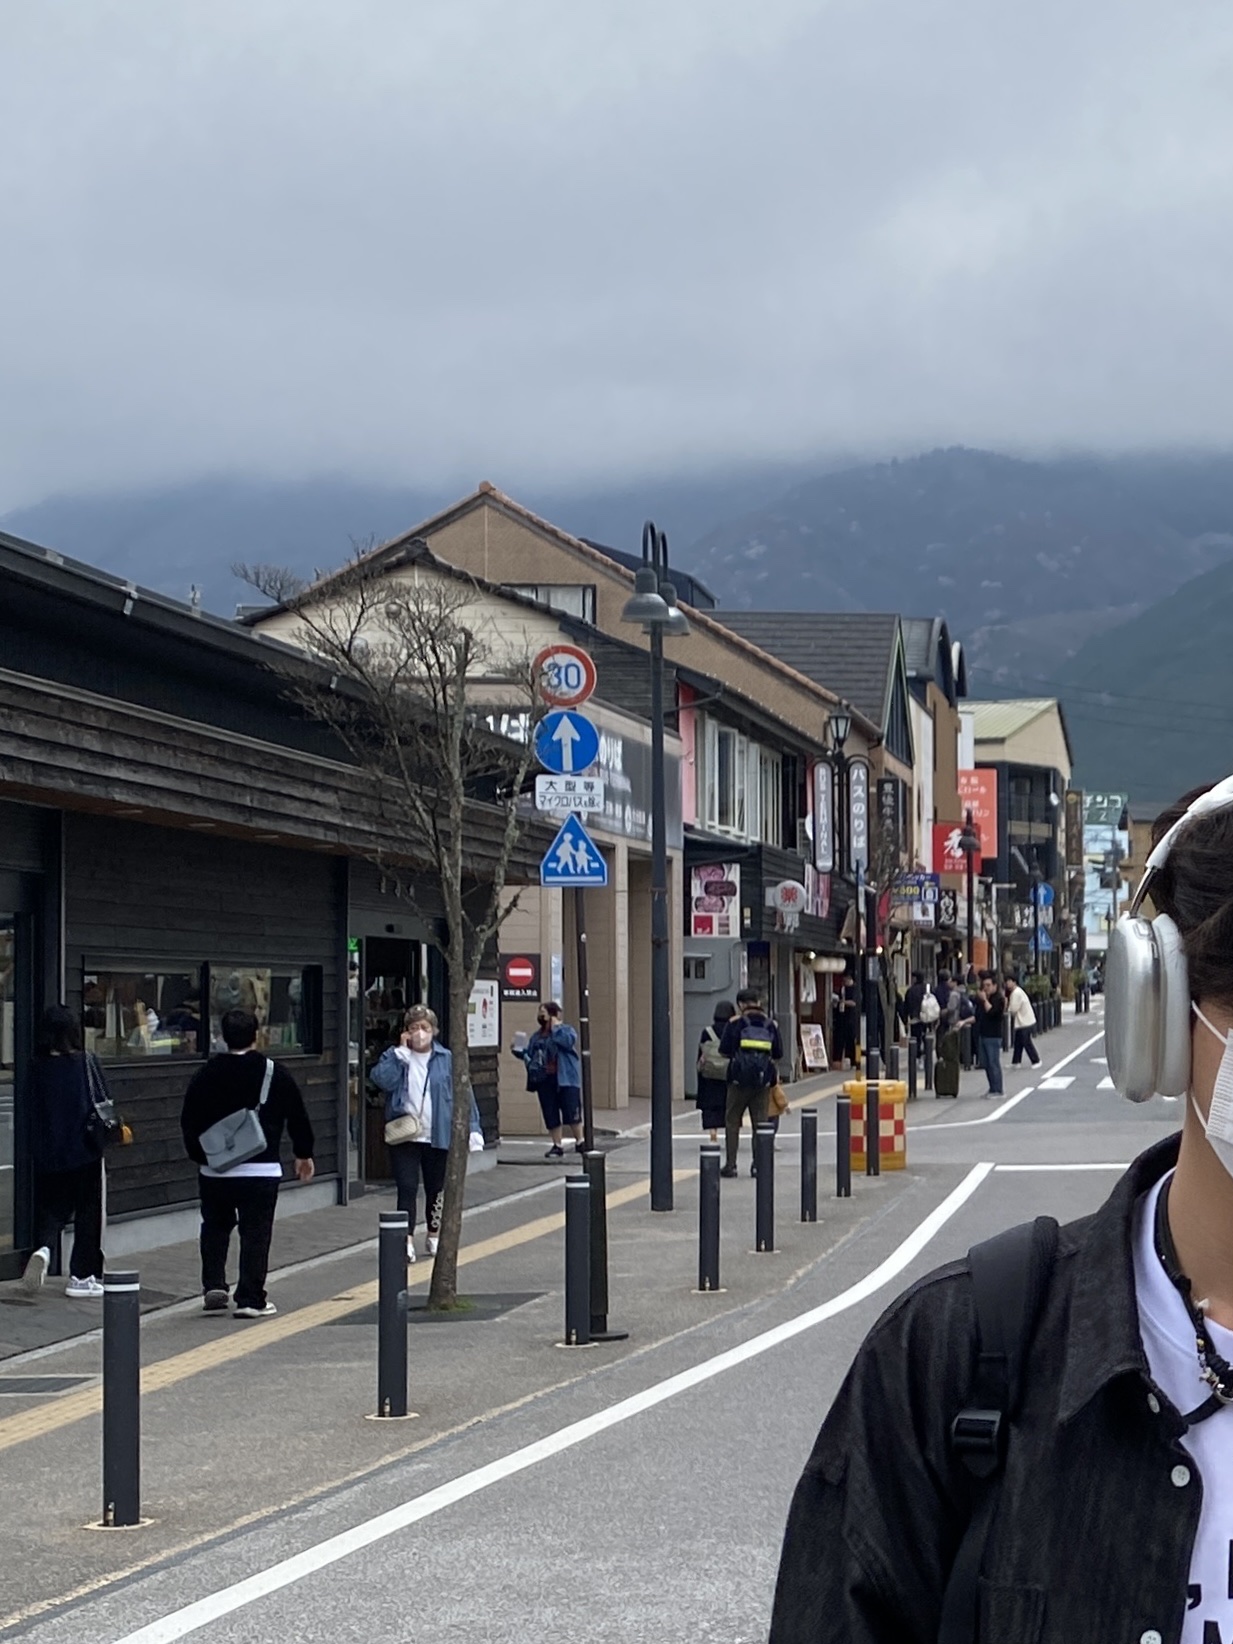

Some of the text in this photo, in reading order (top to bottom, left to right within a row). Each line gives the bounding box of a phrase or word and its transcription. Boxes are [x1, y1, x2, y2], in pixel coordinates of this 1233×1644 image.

[547, 663, 581, 690] 30
[852, 768, 866, 848] バスのりば
